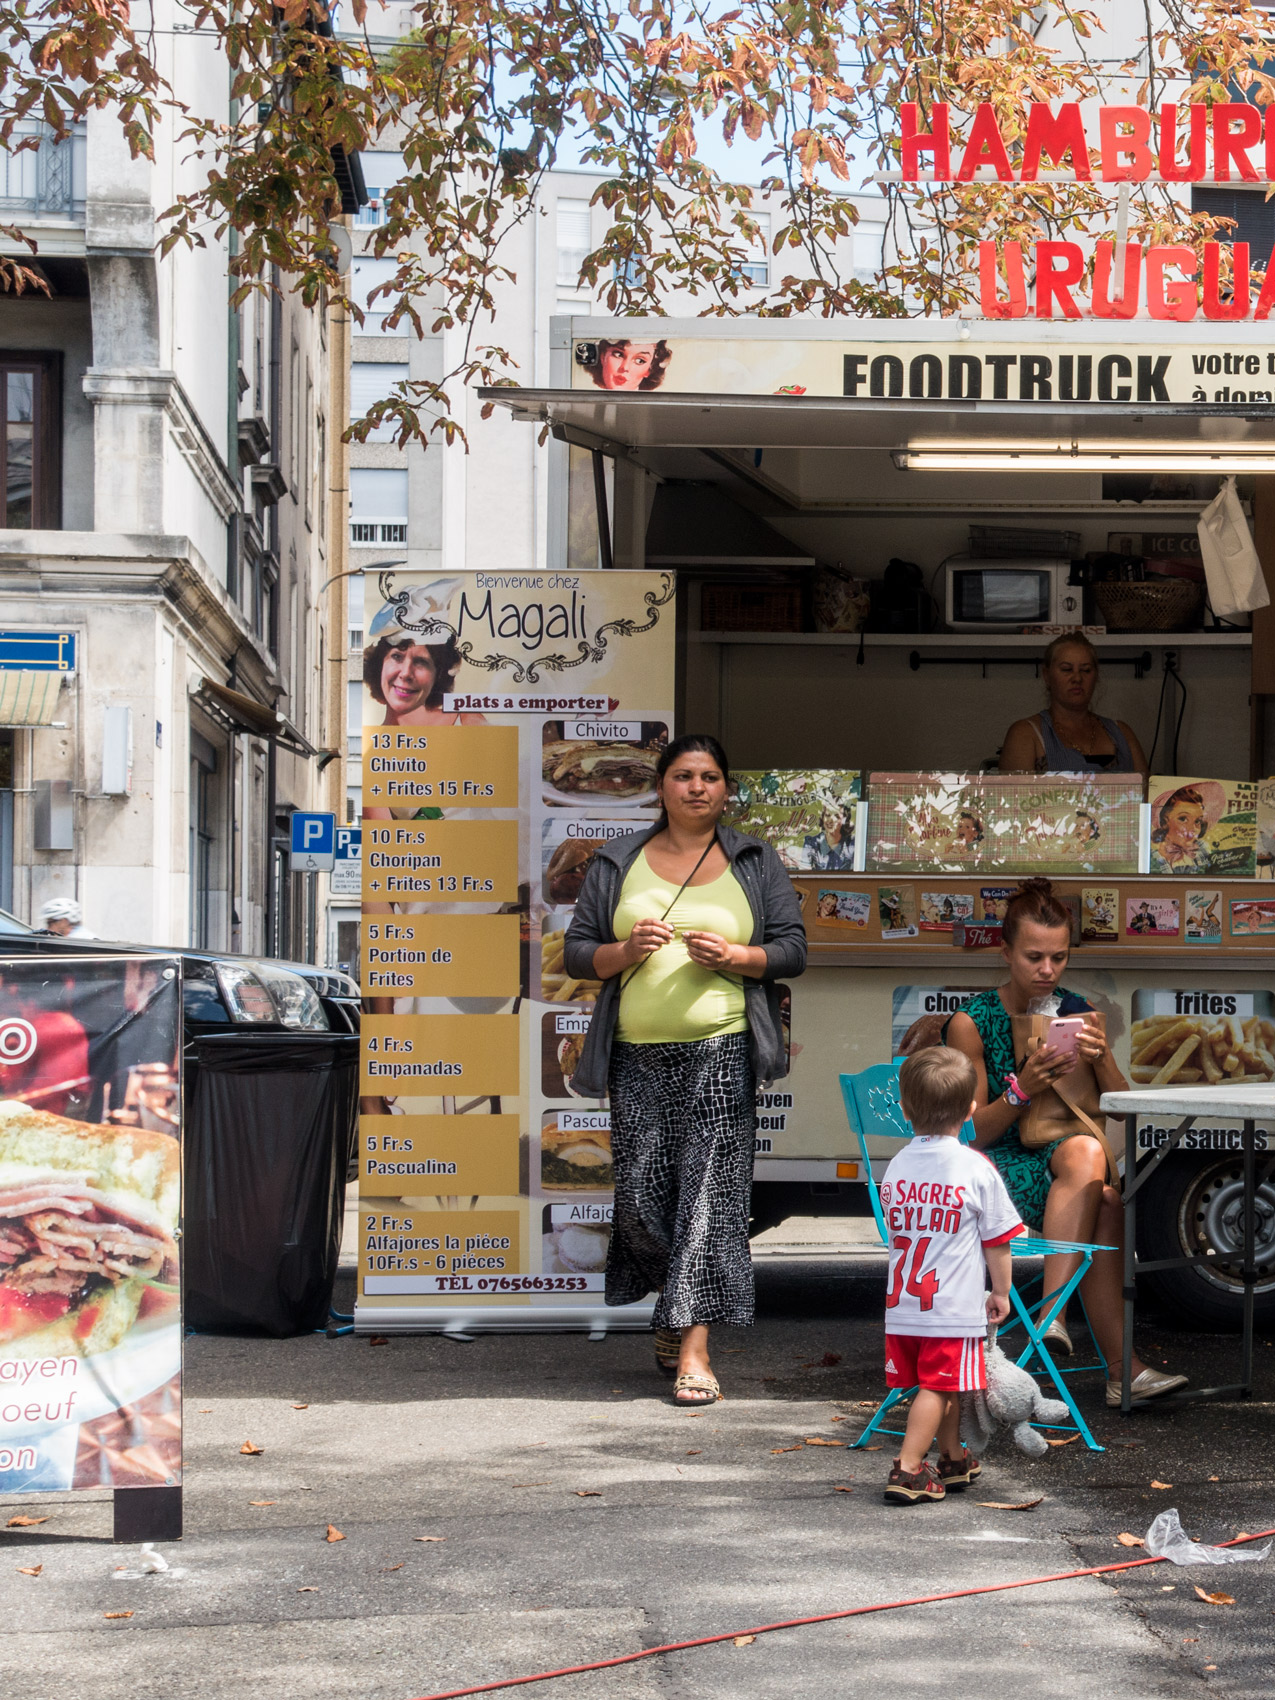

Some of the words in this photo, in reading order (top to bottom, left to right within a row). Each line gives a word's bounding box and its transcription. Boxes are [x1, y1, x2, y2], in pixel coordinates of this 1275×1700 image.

[1191, 353, 1260, 375] votre
[843, 353, 1171, 401] FOODTRUCK
[1152, 538, 1175, 552] ICE
[475, 572, 543, 589] Bienvenue
[547, 573, 580, 590] chez
[457, 589, 588, 650] Magali
[453, 695, 499, 711] plats
[504, 699, 513, 709] a
[518, 695, 606, 712] emporter
[575, 723, 629, 738] Chivito
[372, 735, 391, 749] 13
[397, 735, 427, 749] Fr.s
[370, 757, 427, 773] Chivito
[371, 785, 382, 796] +
[387, 780, 433, 797] Frites
[438, 781, 458, 797] 15
[463, 781, 494, 797] Fr.s
[304, 820, 324, 849] P
[371, 829, 391, 844] 10
[396, 829, 426, 844] Fr.s
[566, 823, 635, 840] Choripan
[338, 831, 351, 850] P
[369, 851, 442, 869] Choripan
[345, 870, 355, 878] 90
[370, 880, 381, 891] +
[386, 876, 433, 891] Frites
[437, 876, 457, 891] 13
[462, 876, 494, 891] Fr.s
[368, 924, 379, 940] 5
[385, 924, 414, 940] Fr.s
[969, 928, 992, 945] Thé
[368, 948, 426, 964] Portion
[431, 948, 452, 964] de
[368, 971, 414, 987] Frites
[925, 993, 975, 1013] cho
[1175, 992, 1237, 1015] frites
[368, 1038, 379, 1051] 4
[384, 1037, 413, 1051] Fr.s
[368, 1060, 463, 1078] Empanadas
[367, 1136, 378, 1152] 5
[382, 1136, 413, 1151] Fr.s
[1185, 1128, 1268, 1150] saucs
[366, 1159, 457, 1176] Pascualina
[895, 1179, 966, 1210] SAGRES
[366, 1215, 378, 1231] 2
[381, 1215, 413, 1231] Fr.s
[886, 1207, 961, 1235] EYLAN
[366, 1234, 440, 1253] Alfajores
[445, 1235, 460, 1250] la
[465, 1234, 510, 1252] piéce
[367, 1255, 418, 1270] 10Fr.s
[436, 1255, 446, 1270] 6
[451, 1254, 506, 1272] piéces
[435, 1273, 473, 1290] TÈL
[478, 1276, 588, 1291] 0765663253
